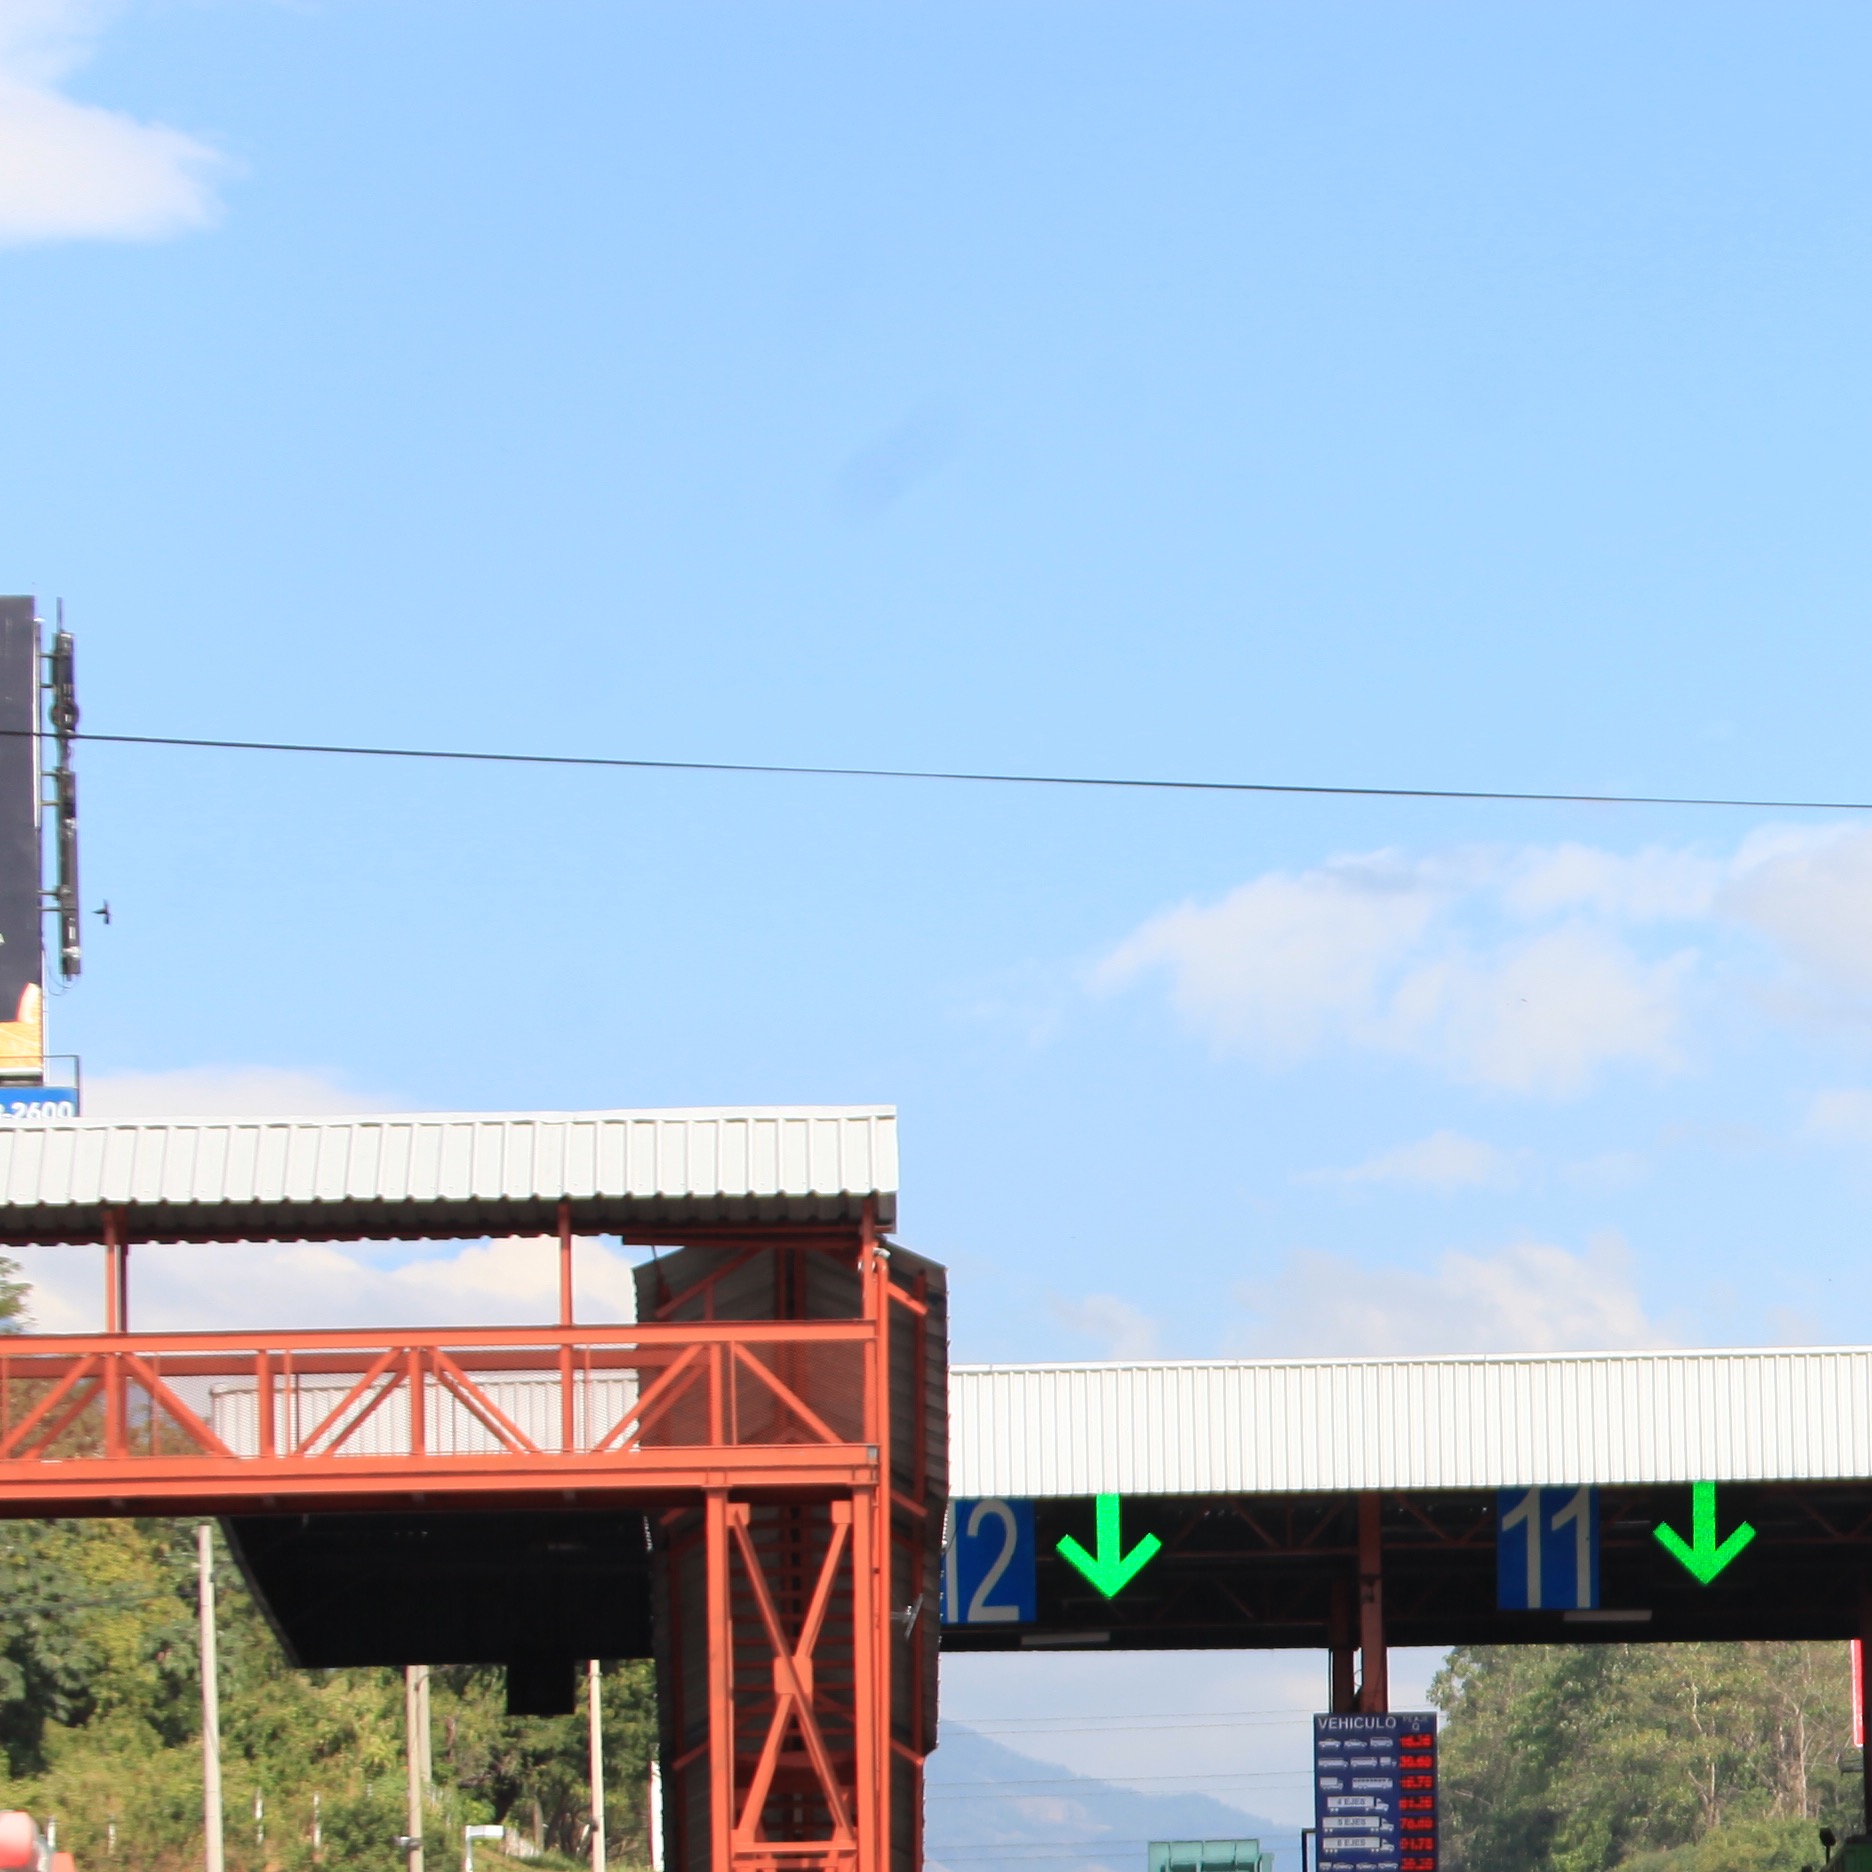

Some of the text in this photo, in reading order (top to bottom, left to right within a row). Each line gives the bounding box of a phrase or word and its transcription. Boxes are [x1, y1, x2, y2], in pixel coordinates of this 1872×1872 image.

[0, 1100, 74, 1119] -2600
[1502, 1485, 1591, 1609] 11
[1318, 1716, 1397, 1730] VEHICULO
[1411, 1722, 1421, 1732] Q
